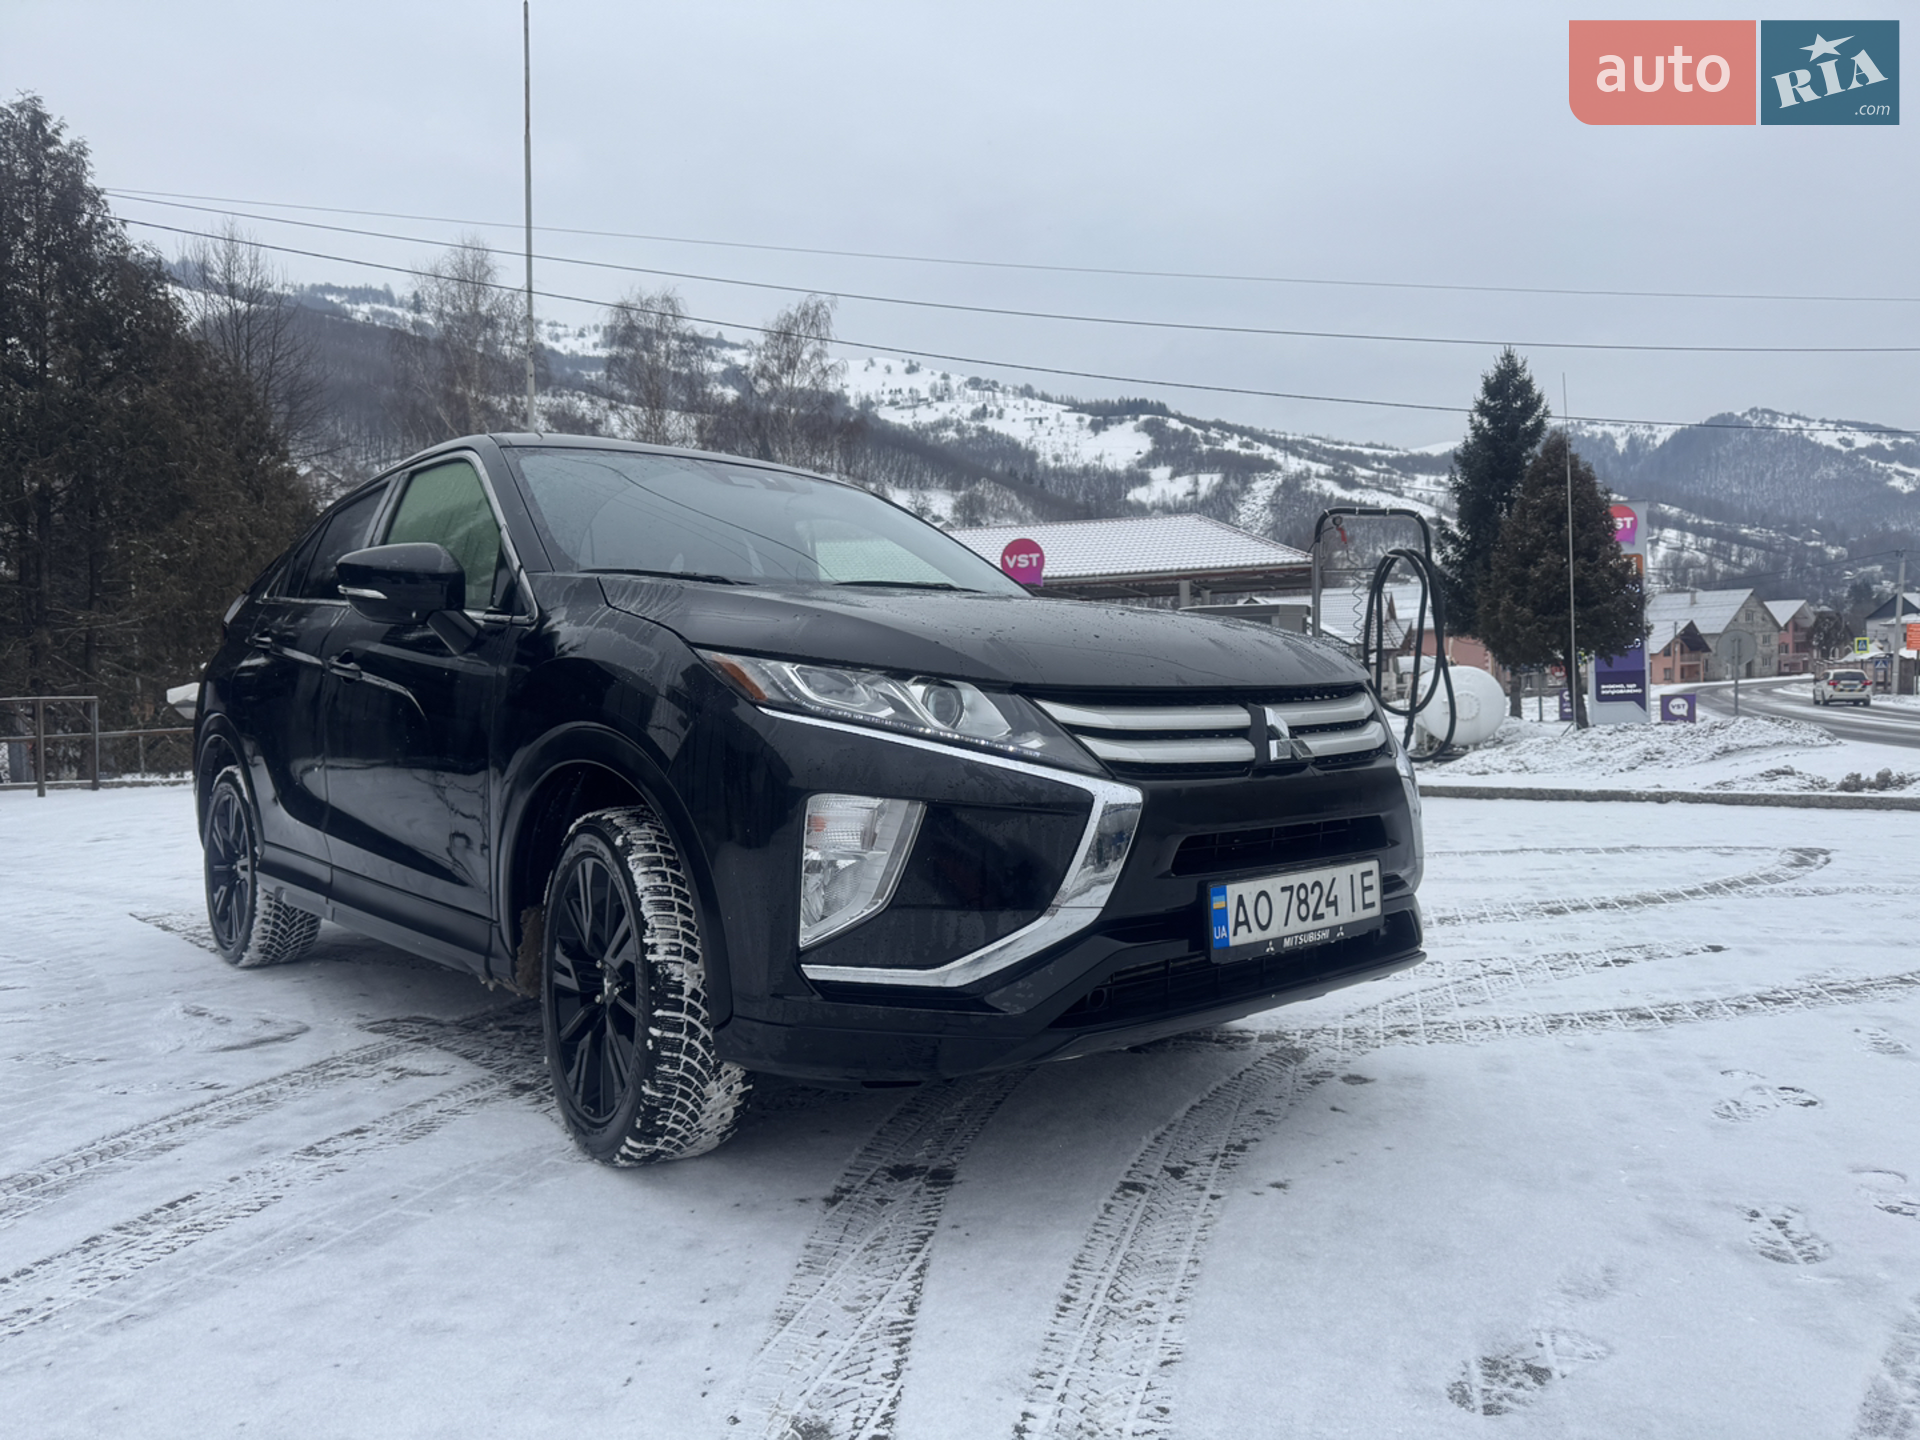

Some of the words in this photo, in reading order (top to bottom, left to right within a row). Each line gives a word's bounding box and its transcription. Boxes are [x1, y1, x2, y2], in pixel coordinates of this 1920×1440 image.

[1613, 516, 1635, 529] ST
[1004, 552, 1041, 569] VST
[1232, 890, 1273, 937] AO
[1280, 877, 1339, 927] 7824
[1350, 869, 1376, 913] IE
[1213, 924, 1228, 940] UA
[1282, 928, 1331, 948] MITSUBISHI
